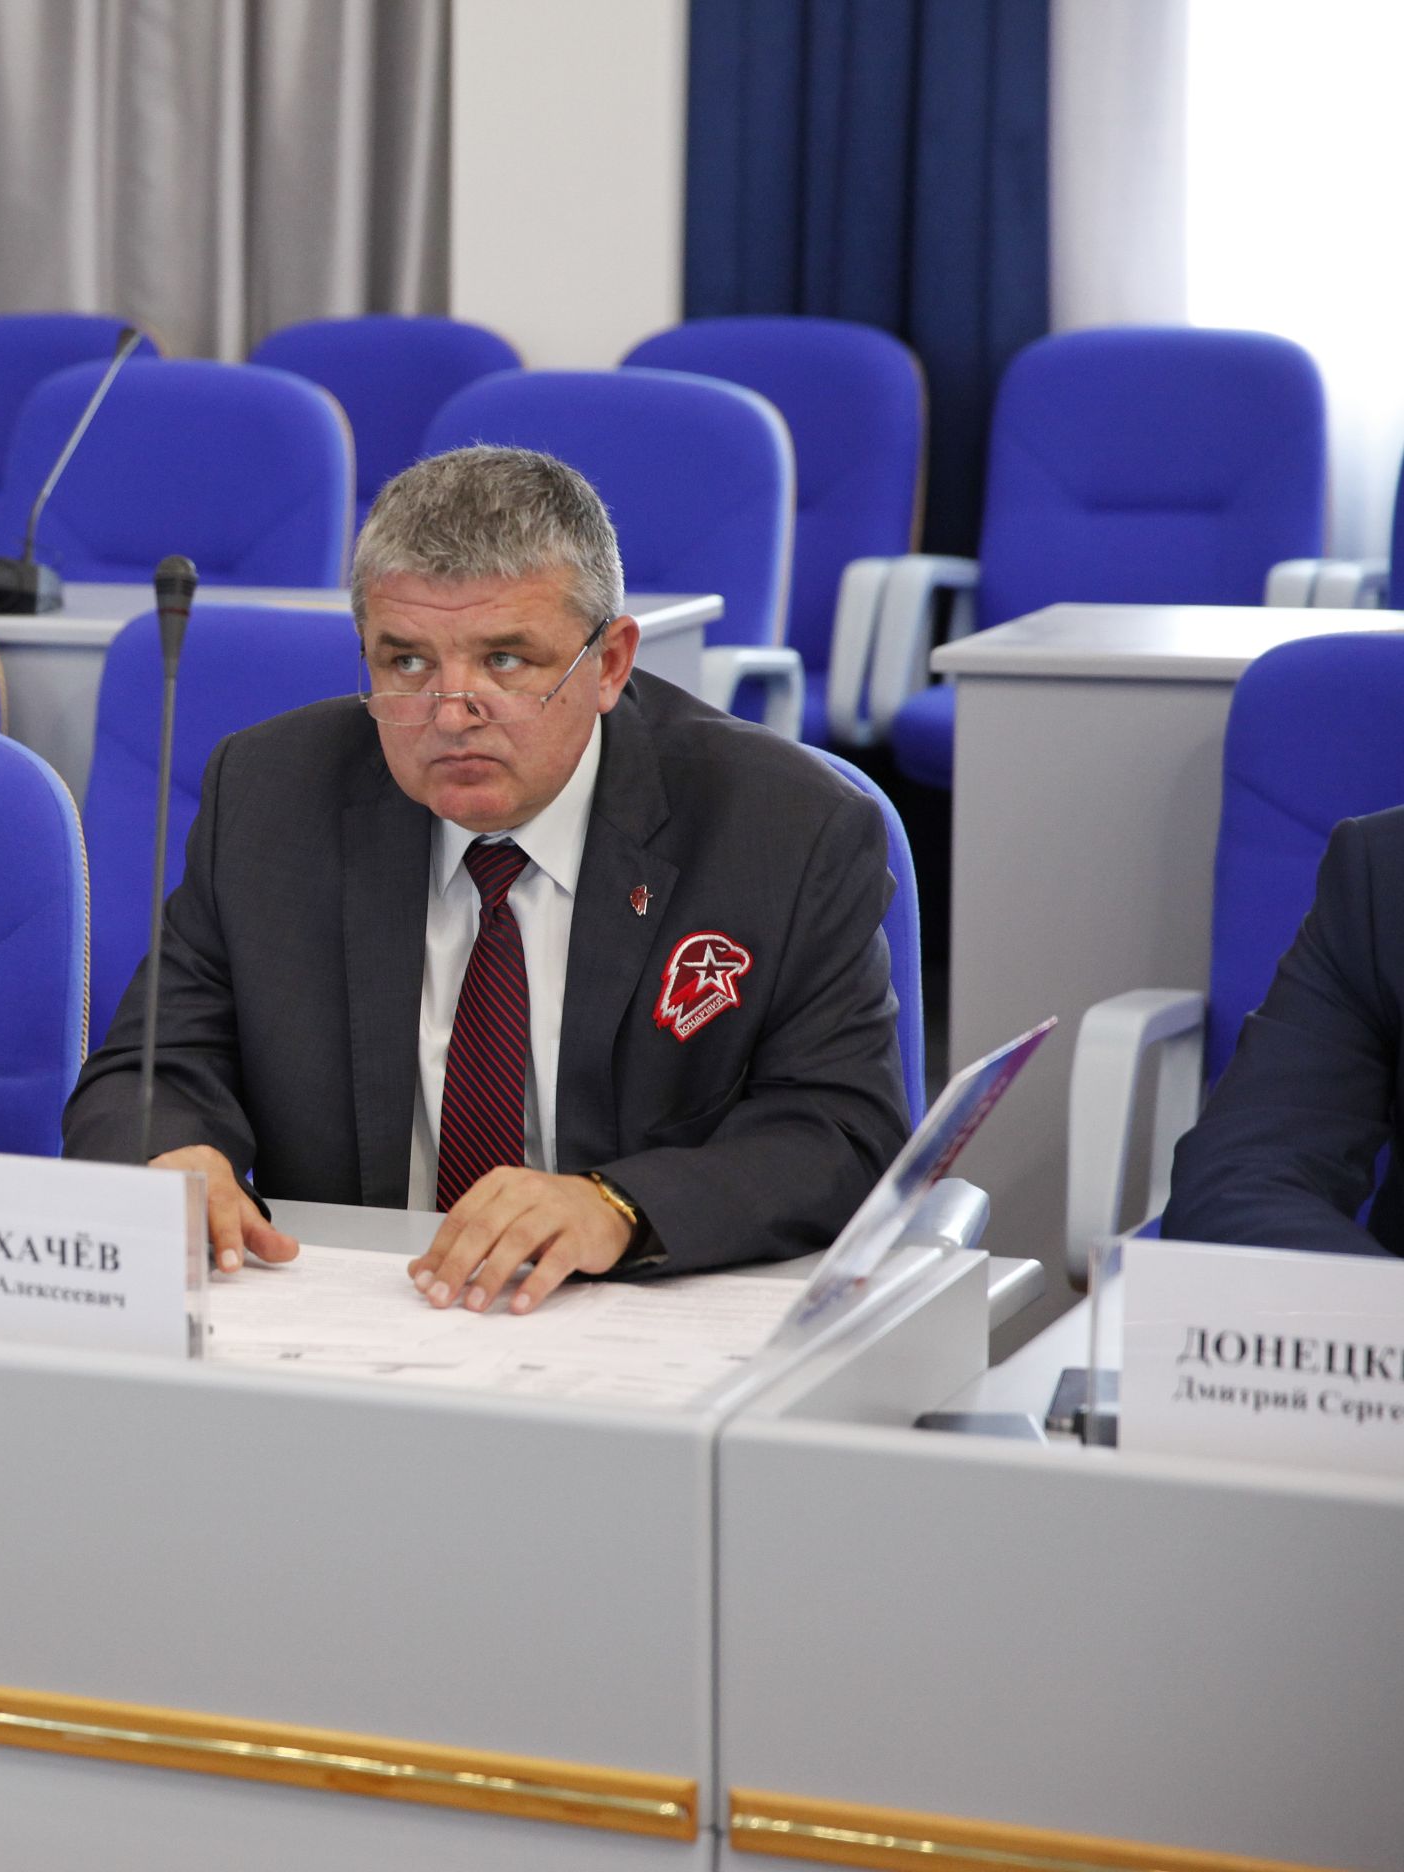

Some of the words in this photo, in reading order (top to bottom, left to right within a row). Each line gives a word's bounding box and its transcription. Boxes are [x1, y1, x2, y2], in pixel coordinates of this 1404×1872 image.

[679, 996, 724, 1035] ЮНАРМИЯ
[1175, 1326, 1404, 1385] ДОНЕЦК
[1173, 1374, 1309, 1413] Дмитрий
